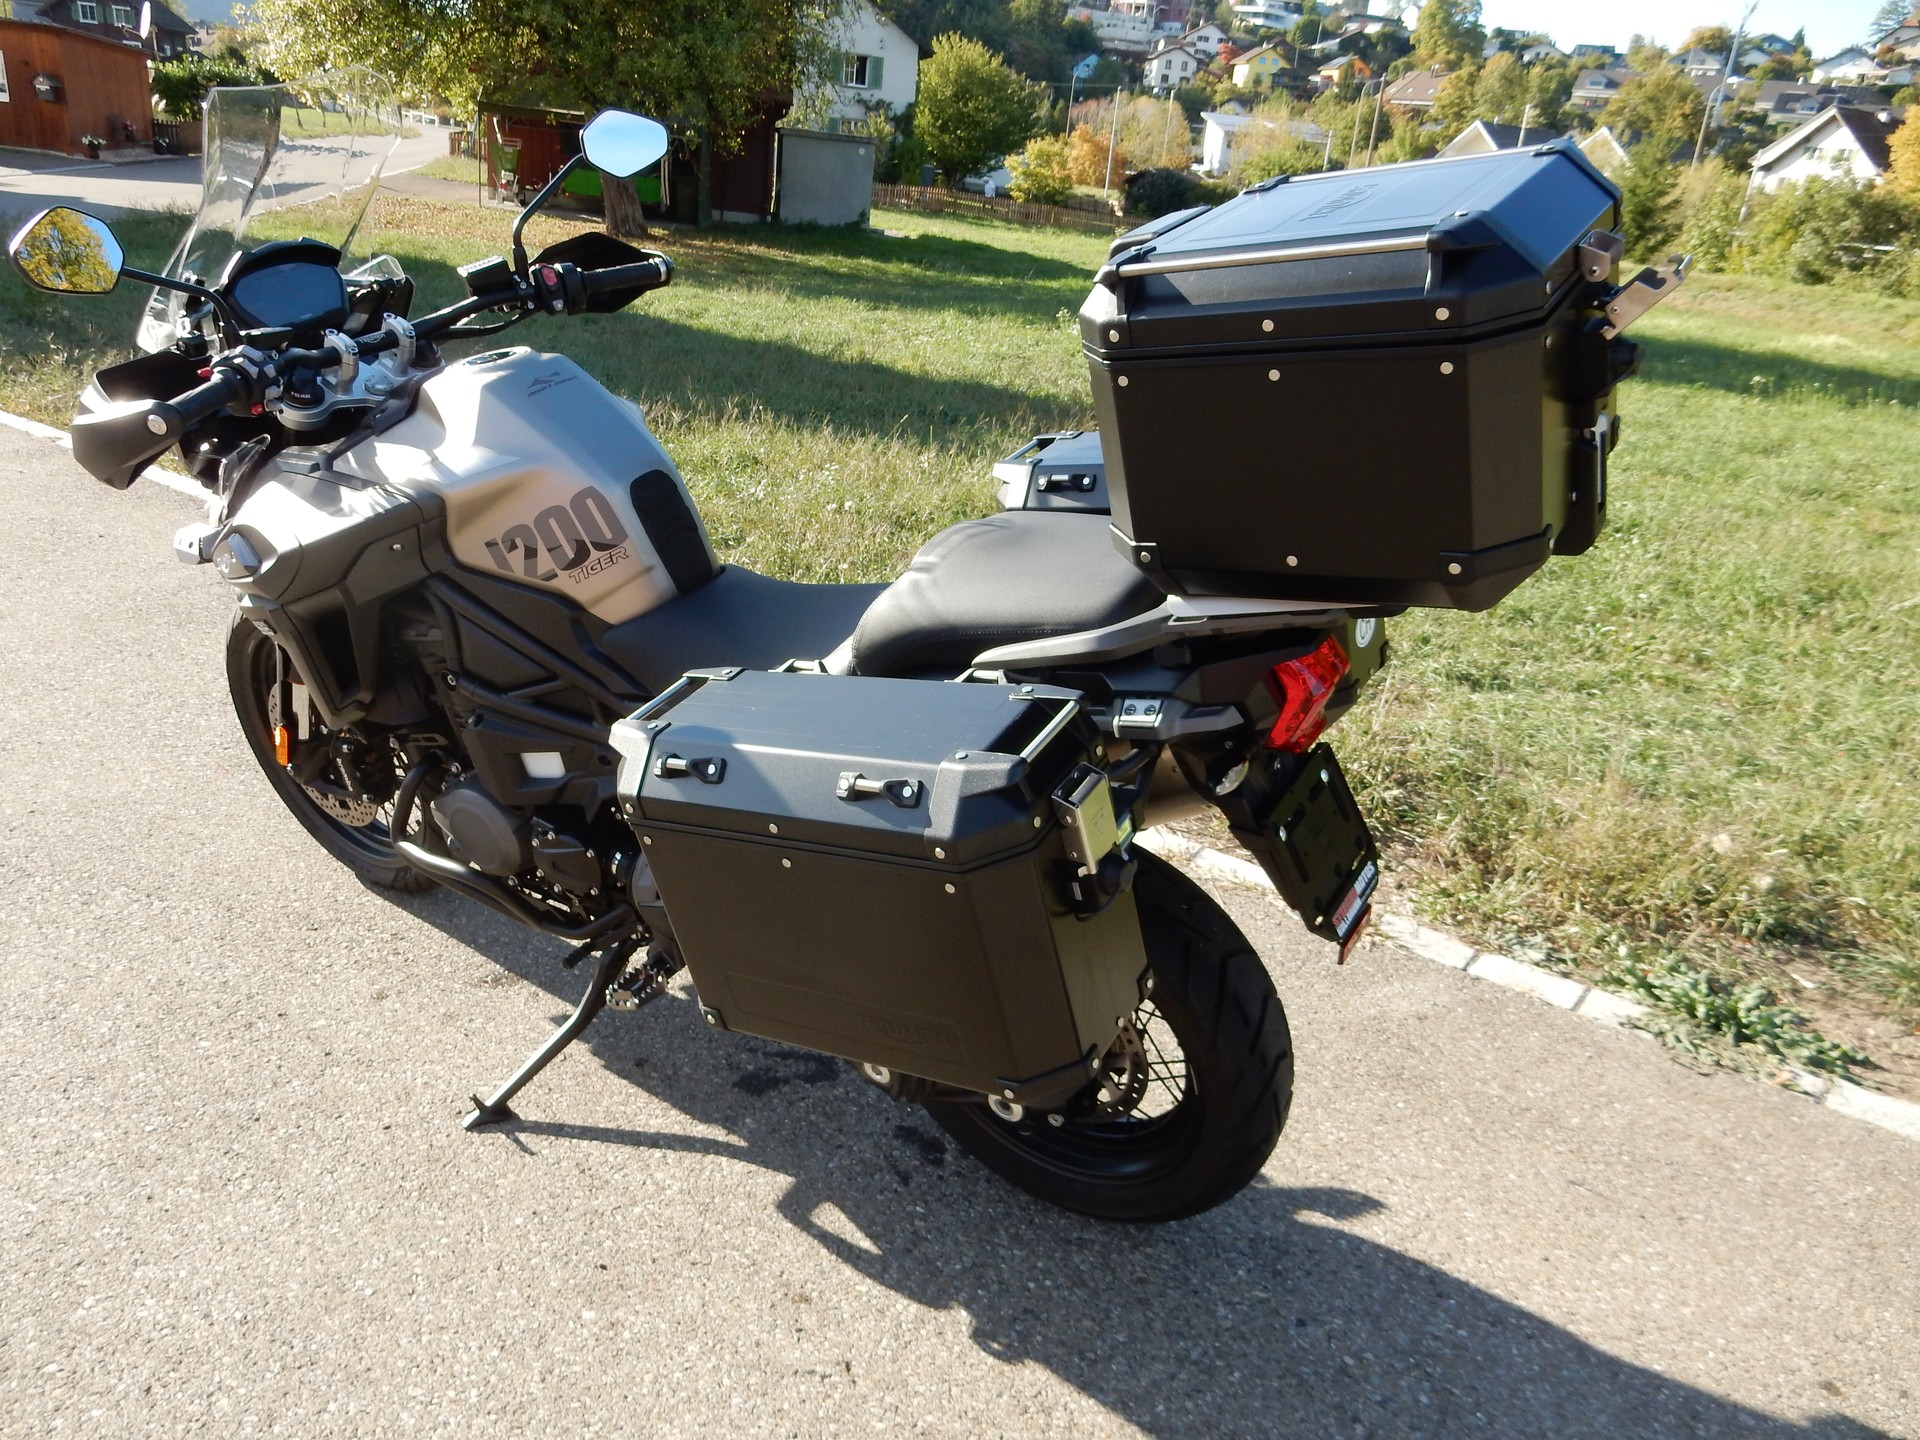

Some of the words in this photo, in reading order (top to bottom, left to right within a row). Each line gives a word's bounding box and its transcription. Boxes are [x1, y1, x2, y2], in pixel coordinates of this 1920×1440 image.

[484, 485, 629, 582] 1200
[568, 545, 629, 584] TIGER
[1353, 860, 1376, 897] MOTOS
